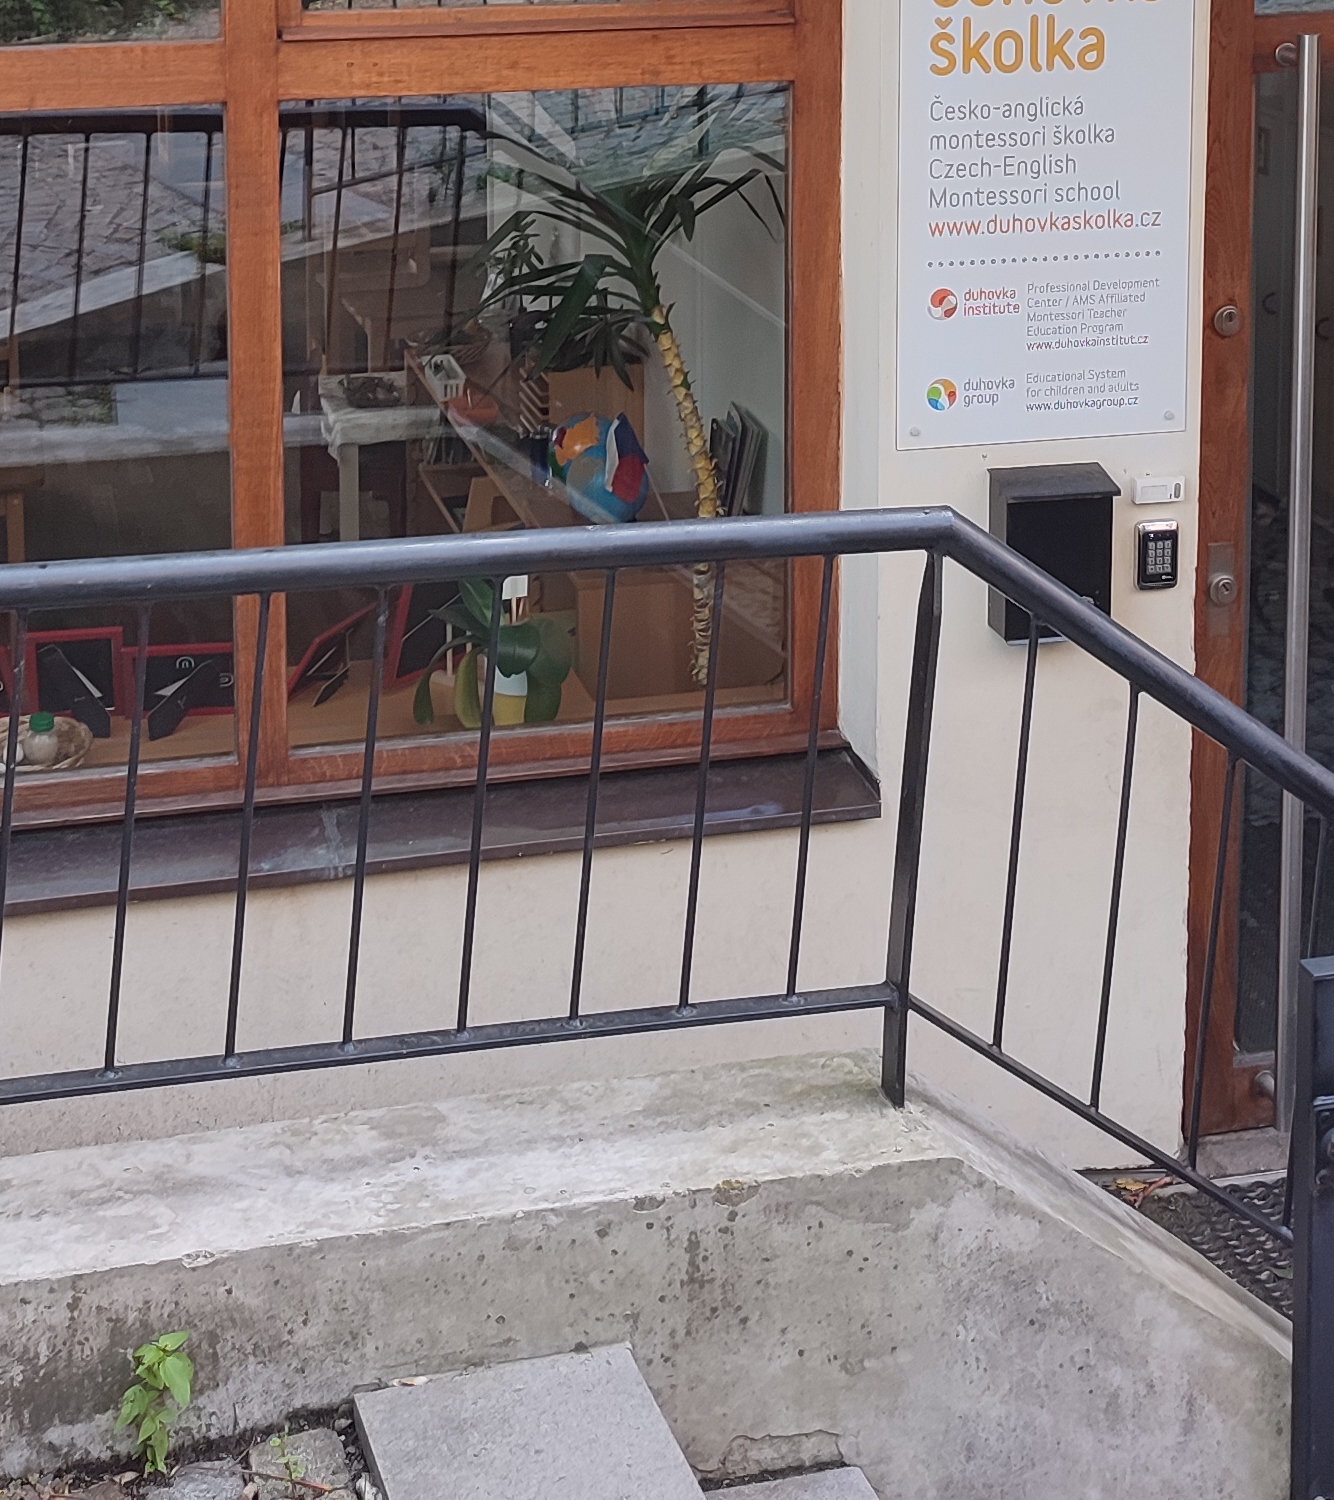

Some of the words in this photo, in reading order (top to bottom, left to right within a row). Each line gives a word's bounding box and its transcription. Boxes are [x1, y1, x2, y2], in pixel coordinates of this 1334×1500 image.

[929, 14, 1106, 77] školka
[929, 95, 1085, 122] Česko-anglická
[929, 126, 1046, 151] montessori
[1052, 124, 1116, 146] školka
[929, 153, 1077, 180] Czech-English
[929, 182, 1048, 209] Montessori
[1054, 180, 1121, 203] school
[928, 208, 1162, 238] www.duhovkaskolka.cz
[1027, 280, 1090, 294] Professional
[1093, 277, 1160, 291] Development
[964, 287, 1017, 302] duhovka
[1027, 296, 1063, 309] Center
[1072, 294, 1096, 306] AMS
[1098, 291, 1146, 304] Affiliated
[963, 302, 1020, 317] institute
[1027, 309, 1085, 323] Montessori
[1087, 307, 1127, 319] Teacher
[1026, 324, 1078, 337] Education
[1080, 322, 1124, 336] Program
[1026, 334, 1149, 351] www.duhovkainstitut.cz
[963, 376, 1016, 392] duhovka
[1026, 369, 1086, 384] Educational
[1087, 369, 1126, 382] System
[1026, 386, 1042, 398] for
[1044, 384, 1085, 397] children
[1087, 382, 1105, 394] and
[1108, 380, 1140, 393] adults
[963, 392, 999, 407] group
[1025, 396, 1139, 412] www.duhovkagroup.cz
